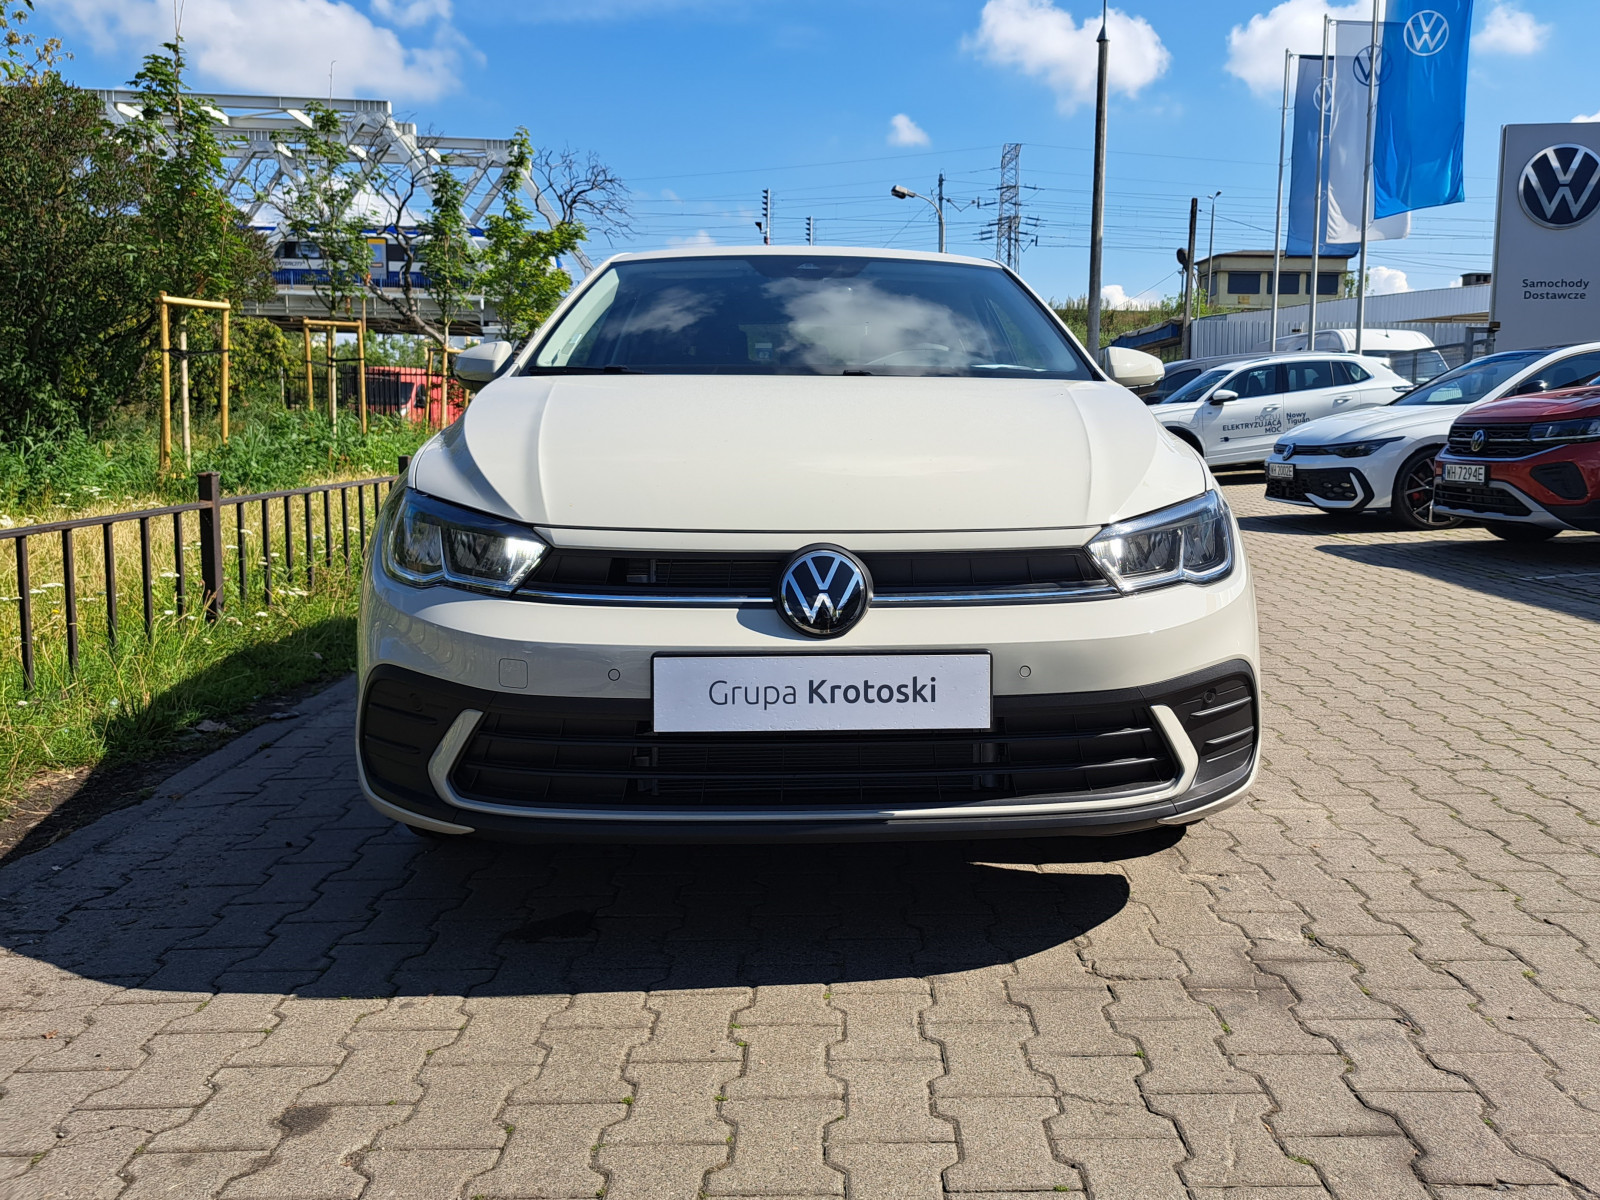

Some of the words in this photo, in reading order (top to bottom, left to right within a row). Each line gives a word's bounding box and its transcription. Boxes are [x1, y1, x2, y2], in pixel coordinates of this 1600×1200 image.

[1522, 278, 1590, 290] Samochody
[1523, 290, 1587, 300] Dostawcze
[1286, 411, 1307, 419] Nowy
[1287, 417, 1310, 426] Tiguan
[1264, 426, 1282, 434] MOC
[1446, 465, 1457, 480] WH
[1458, 466, 1484, 481] 7294E
[708, 680, 797, 711] Grupa
[808, 676, 937, 705] Krotoski
